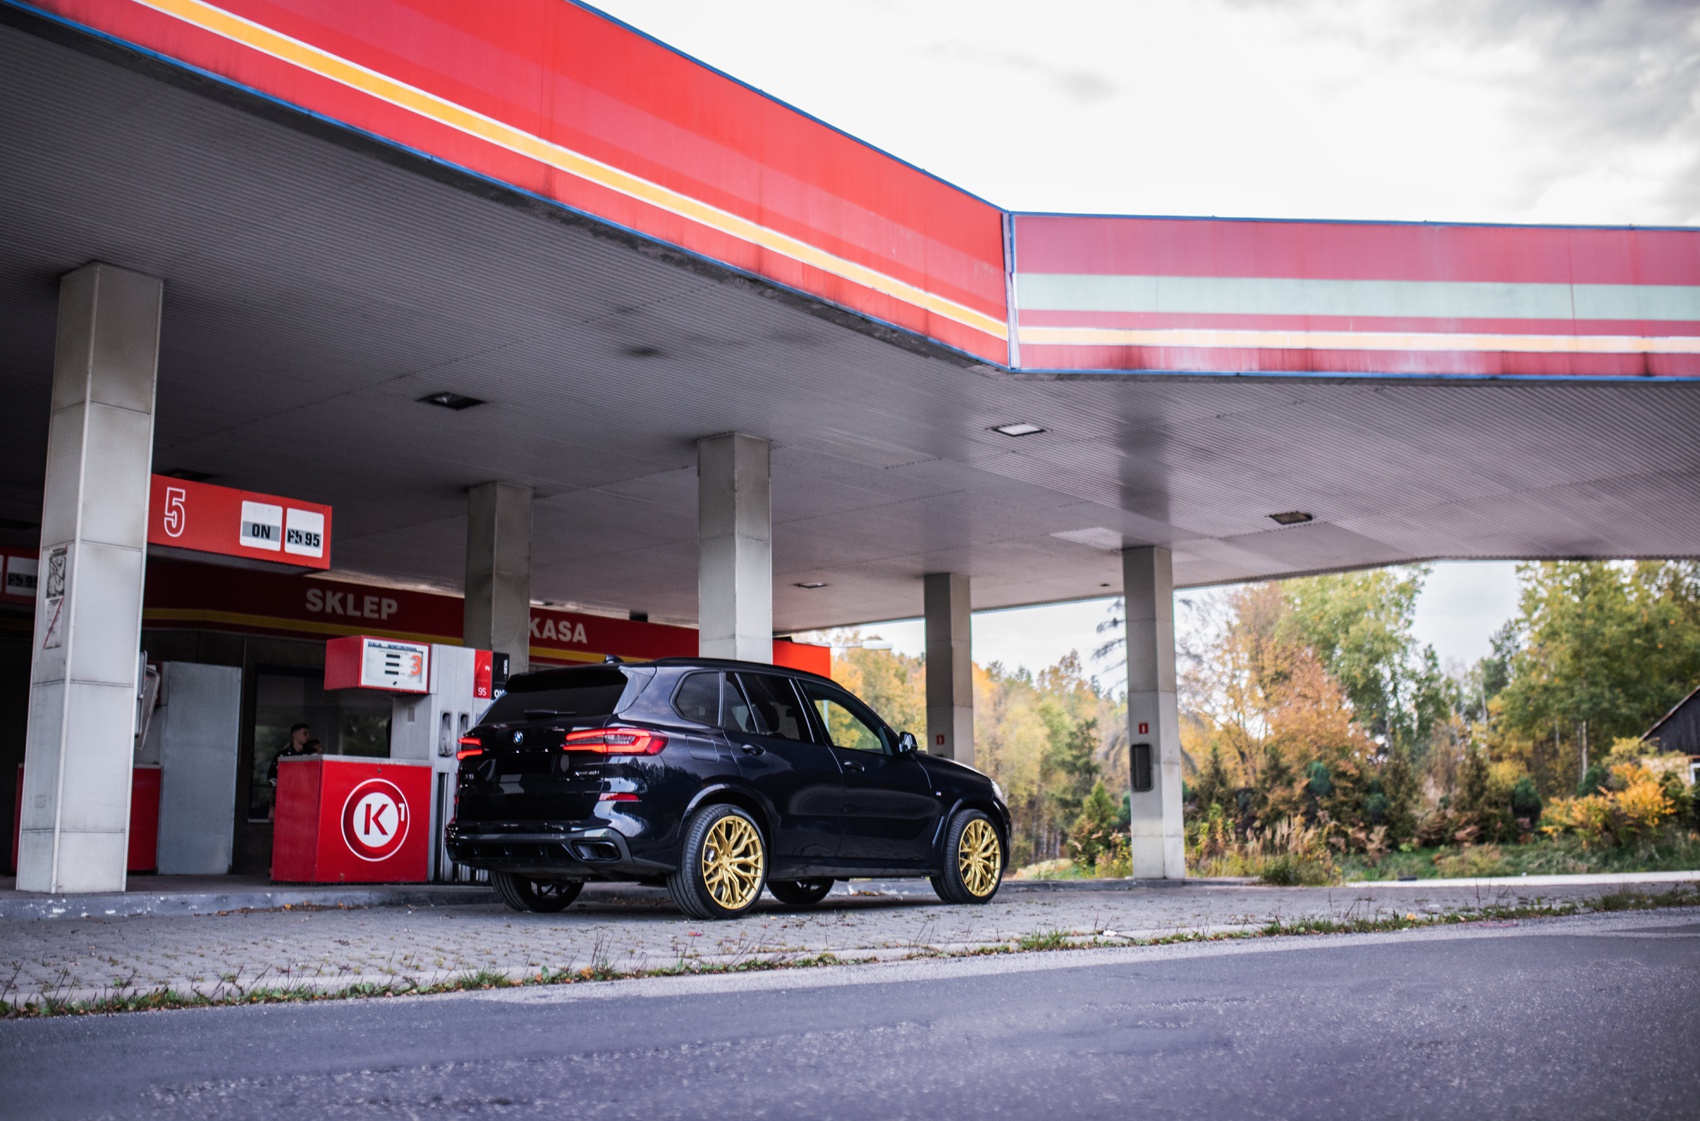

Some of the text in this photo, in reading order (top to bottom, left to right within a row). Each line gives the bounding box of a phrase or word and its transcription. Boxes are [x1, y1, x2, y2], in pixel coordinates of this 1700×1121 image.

[163, 486, 187, 539] 5
[252, 523, 271, 539] ON
[304, 532, 320, 547] 95
[305, 588, 398, 621] SKLEP
[528, 616, 588, 644] KASA
[410, 654, 422, 675] 3
[478, 687, 486, 696] 95
[364, 803, 388, 836] K
